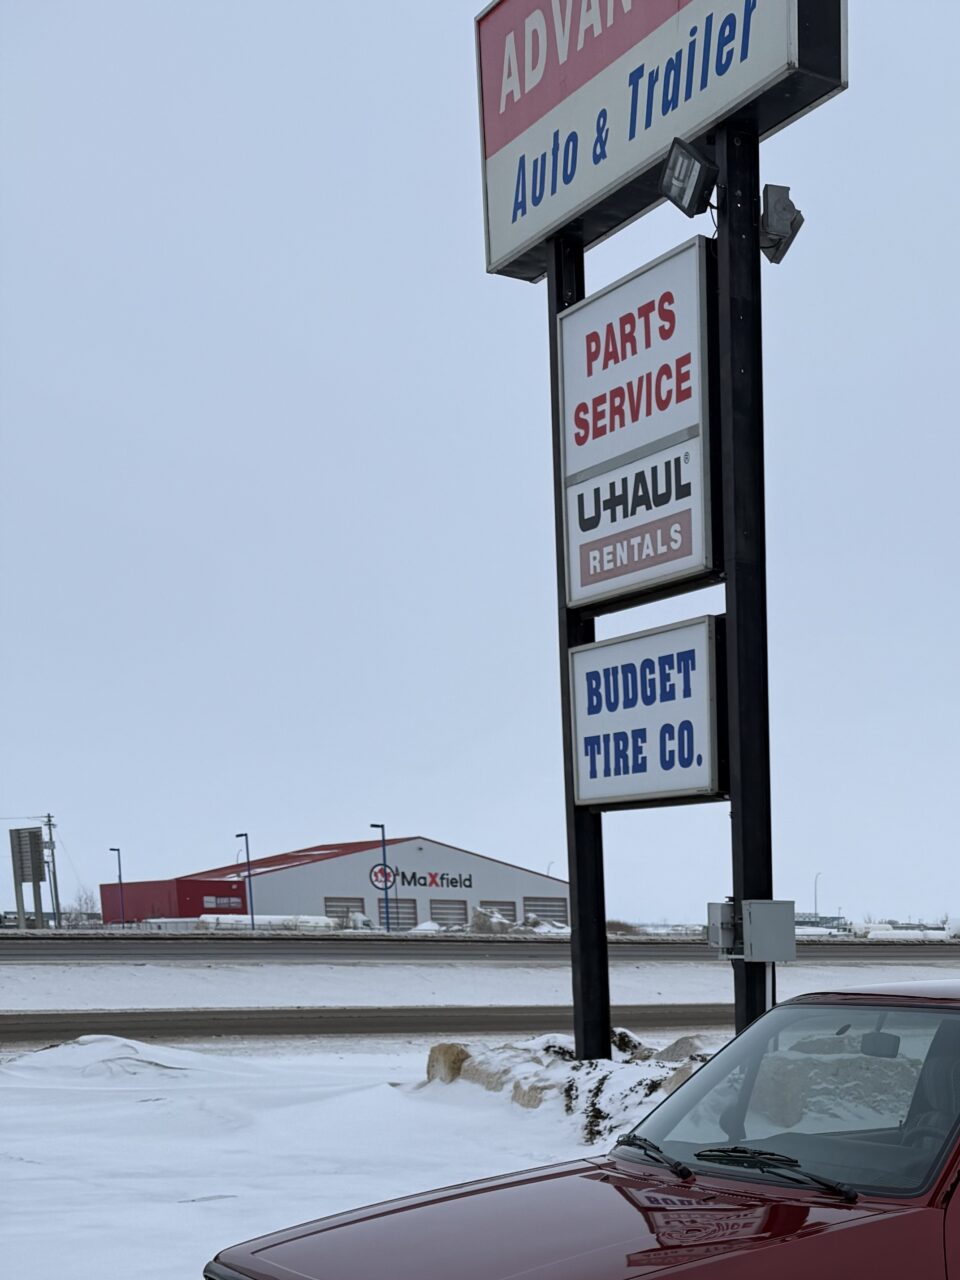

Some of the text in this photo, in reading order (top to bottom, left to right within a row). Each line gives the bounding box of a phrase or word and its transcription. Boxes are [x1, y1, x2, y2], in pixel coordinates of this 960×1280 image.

[511, 0, 757, 224] Auto & Trailer
[586, 291, 676, 377] PARTS
[574, 352, 692, 447] SERVICE
[589, 522, 682, 576] RENTALS
[586, 649, 696, 716] BUDGET
[584, 719, 703, 779] TIRE CO.
[401, 871, 473, 889] MaXfield
